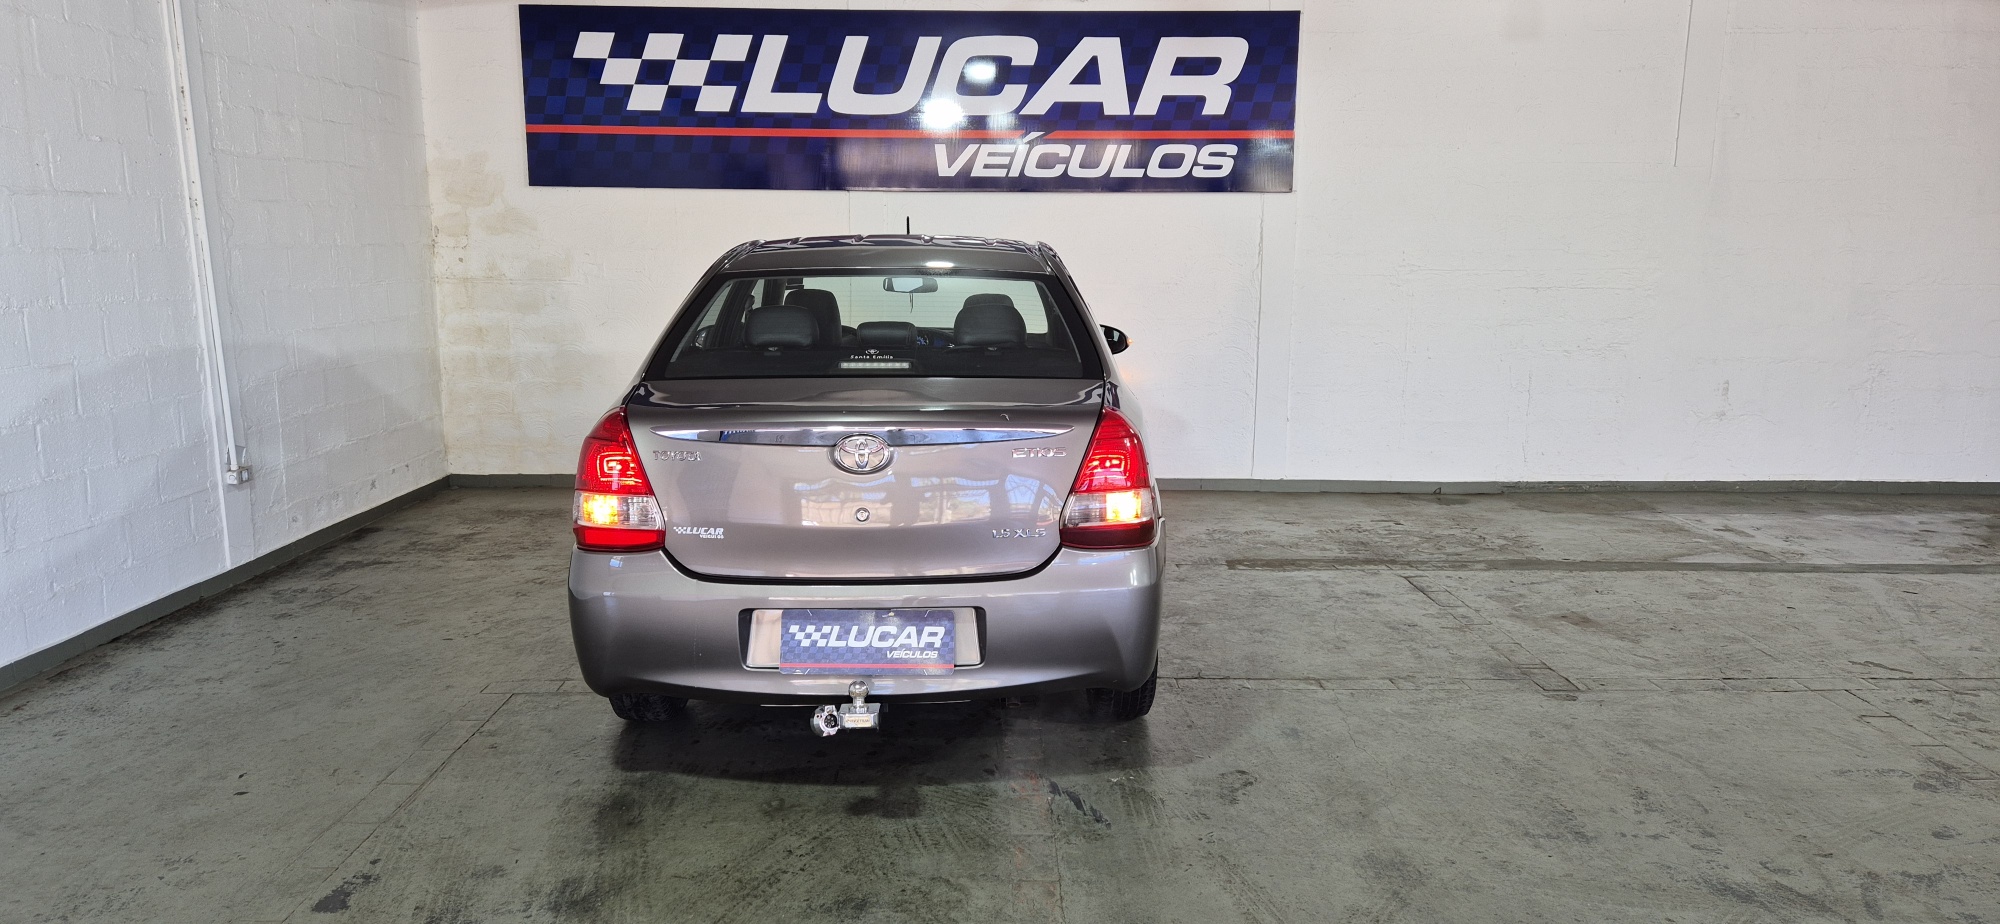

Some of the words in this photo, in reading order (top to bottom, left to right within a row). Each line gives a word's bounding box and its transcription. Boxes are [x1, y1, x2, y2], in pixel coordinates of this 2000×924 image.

[742, 33, 1249, 117] LUCAR
[934, 132, 1238, 178] VEÍCULOS
[653, 450, 701, 461] TOYOTA
[1011, 447, 1067, 458] ETIOS
[686, 526, 724, 535] LUCAR
[1014, 528, 1046, 538] XLS
[827, 625, 945, 648] LUCAR
[886, 648, 938, 659] VEÍCULOS
